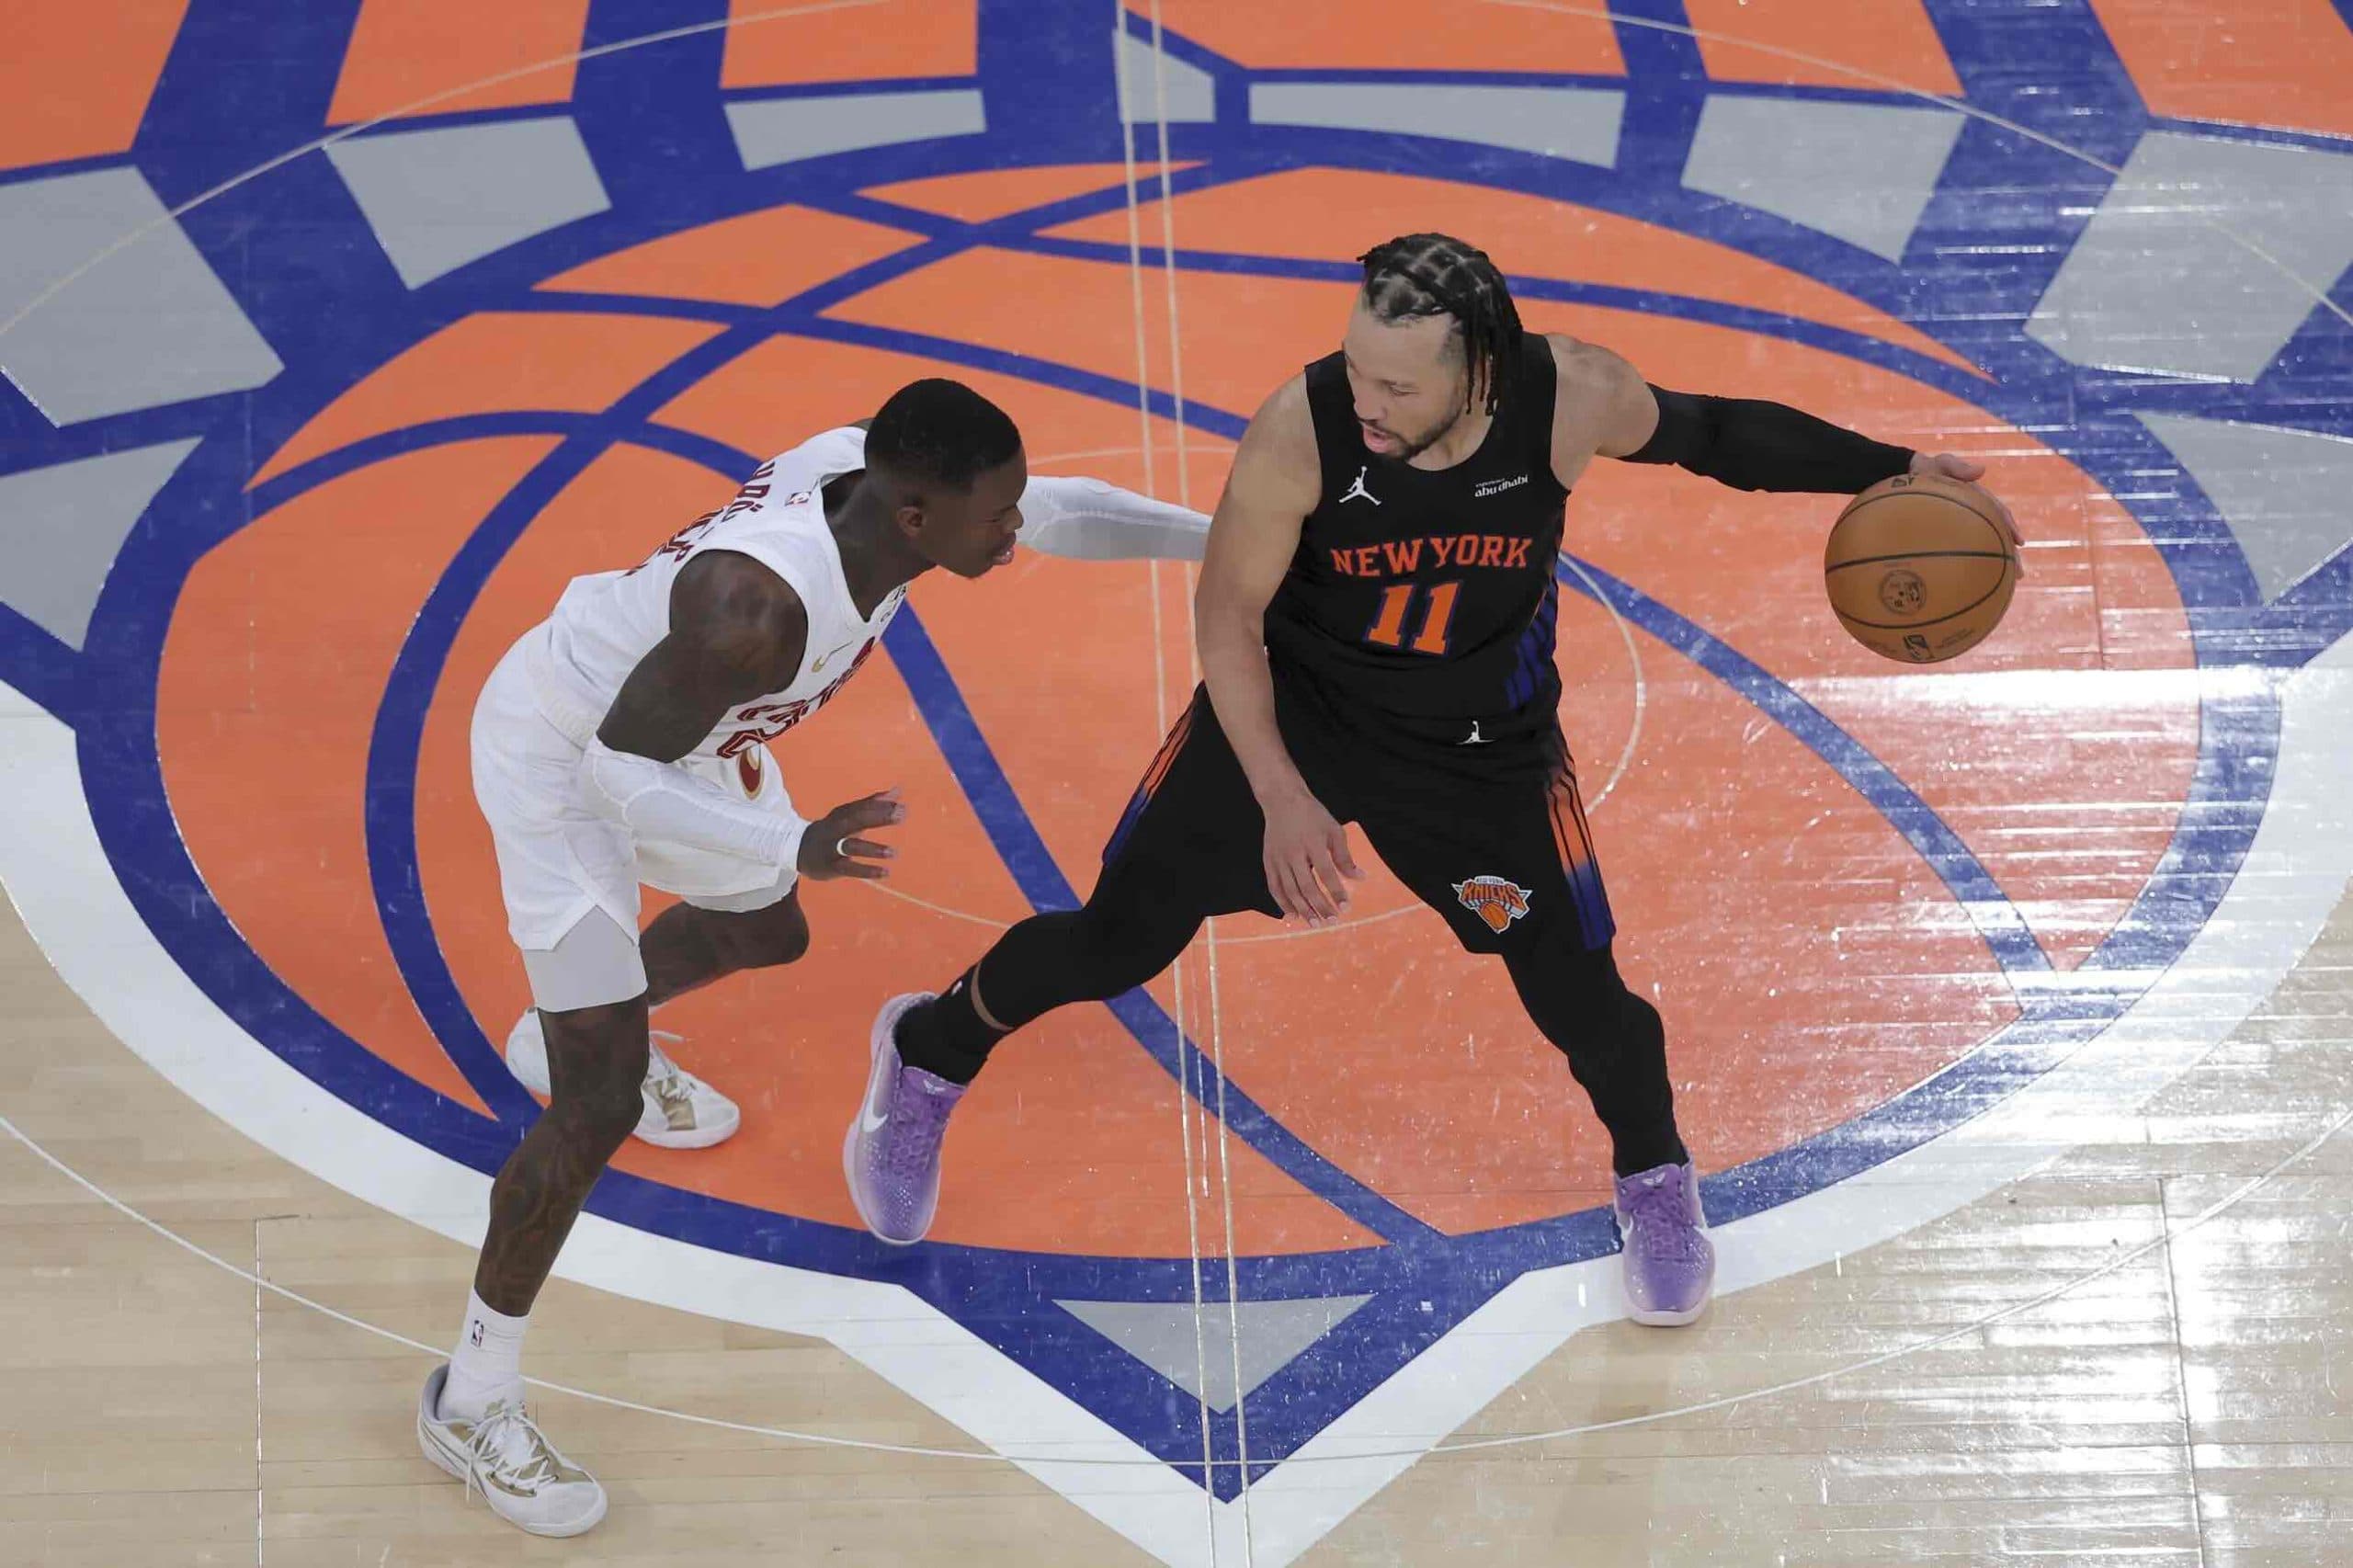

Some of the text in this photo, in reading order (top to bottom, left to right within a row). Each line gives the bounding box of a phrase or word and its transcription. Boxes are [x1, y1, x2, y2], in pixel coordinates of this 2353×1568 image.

[1331, 534, 1533, 576] NEW YORK
[1367, 581, 1460, 655] 11
[1461, 881, 1527, 912] KNICKS
